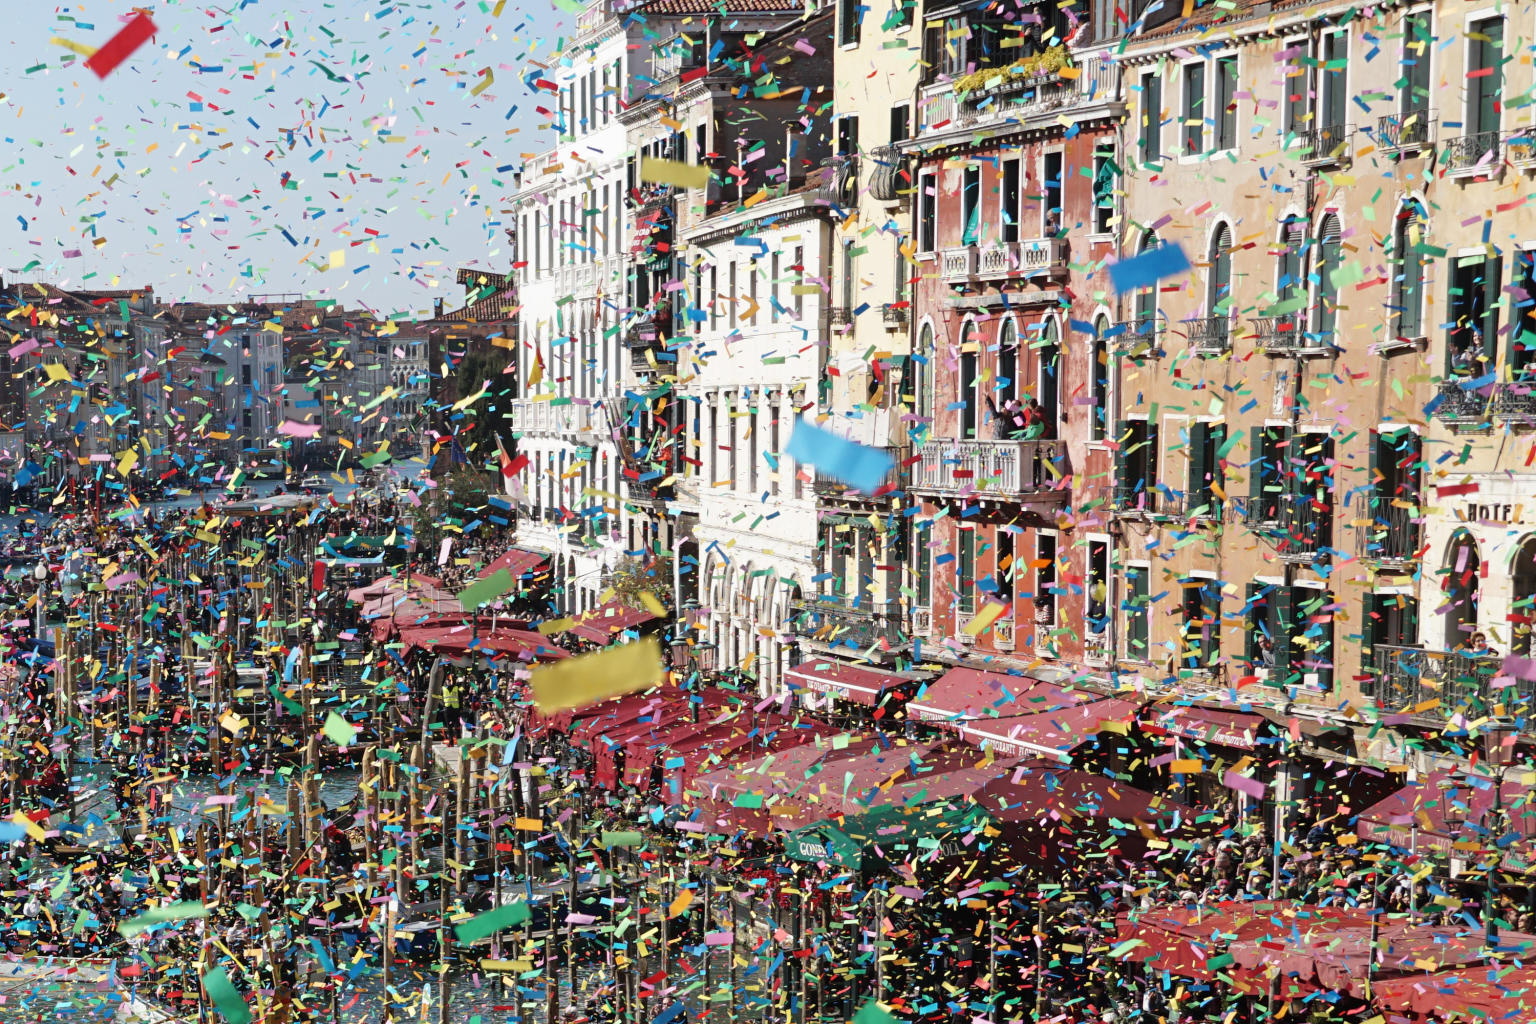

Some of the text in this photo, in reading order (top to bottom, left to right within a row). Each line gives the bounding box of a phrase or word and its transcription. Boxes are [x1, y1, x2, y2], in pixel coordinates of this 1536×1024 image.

[1468, 503, 1525, 525] HOTE
[799, 842, 843, 863] GOND
[916, 841, 960, 859] GOOLA
